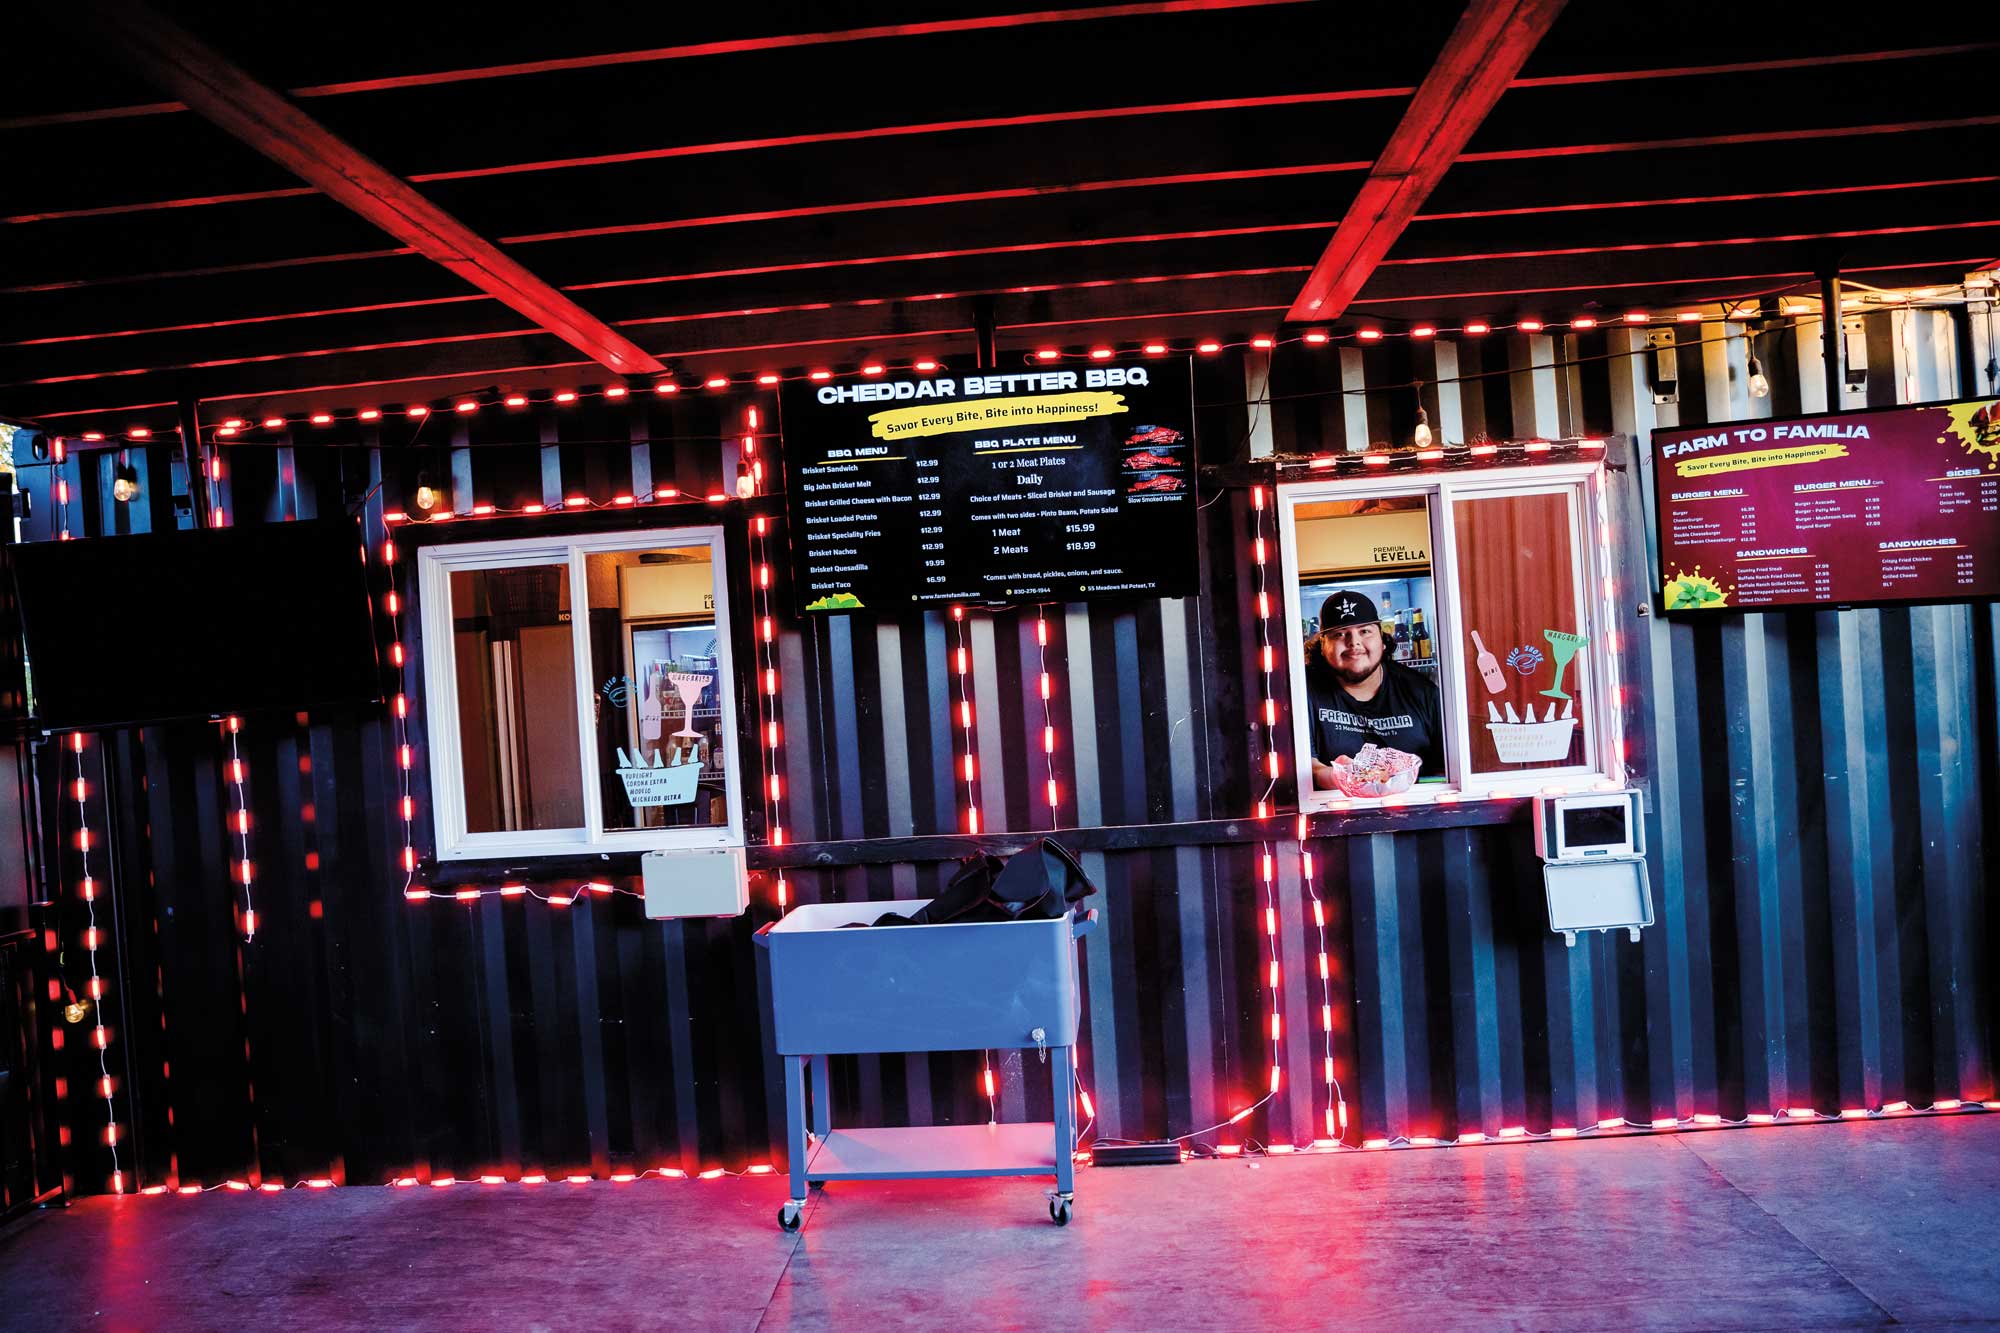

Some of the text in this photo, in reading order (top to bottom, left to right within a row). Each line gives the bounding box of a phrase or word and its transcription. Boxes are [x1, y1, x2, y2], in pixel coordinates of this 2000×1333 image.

[817, 367, 1149, 404] CHEDDAR BETTER BBQ
[887, 403, 1099, 434] Savor Every Bite, Bite into Happiness!
[974, 435, 1076, 449] BBQ PLATE MENU
[1662, 425, 1870, 458] FARM TO FAMILIA
[828, 447, 888, 458] BBQ MENU
[1016, 458, 1038, 467] Meat
[1040, 457, 1066, 466] Plates
[1687, 463, 1707, 471] Savor
[1710, 460, 1731, 469] Every
[1732, 458, 1750, 466] Bite,
[1785, 448, 1827, 459] Happiness!
[827, 465, 858, 473] Sandwich
[1946, 469, 1981, 477] SIDES
[1017, 474, 1043, 485] Daily
[1794, 482, 1836, 491] BURGER
[1840, 479, 1871, 487] MENU
[1672, 488, 1743, 499] BURGER MENU
[829, 498, 850, 506] Grilled
[992, 528, 1021, 537] 1 Meat
[1066, 523, 1095, 533] $15.99
[832, 531, 864, 539] Speciality
[1066, 541, 1096, 551] $18.99
[1879, 538, 1957, 549] SANDWICHES
[994, 545, 1028, 554] 2 Meats
[1736, 547, 1808, 557] SANDWICHES
[1374, 550, 1425, 562] LEVELLA
[834, 564, 868, 572] Quesadilla
[1043, 570, 1066, 578] pickles,
